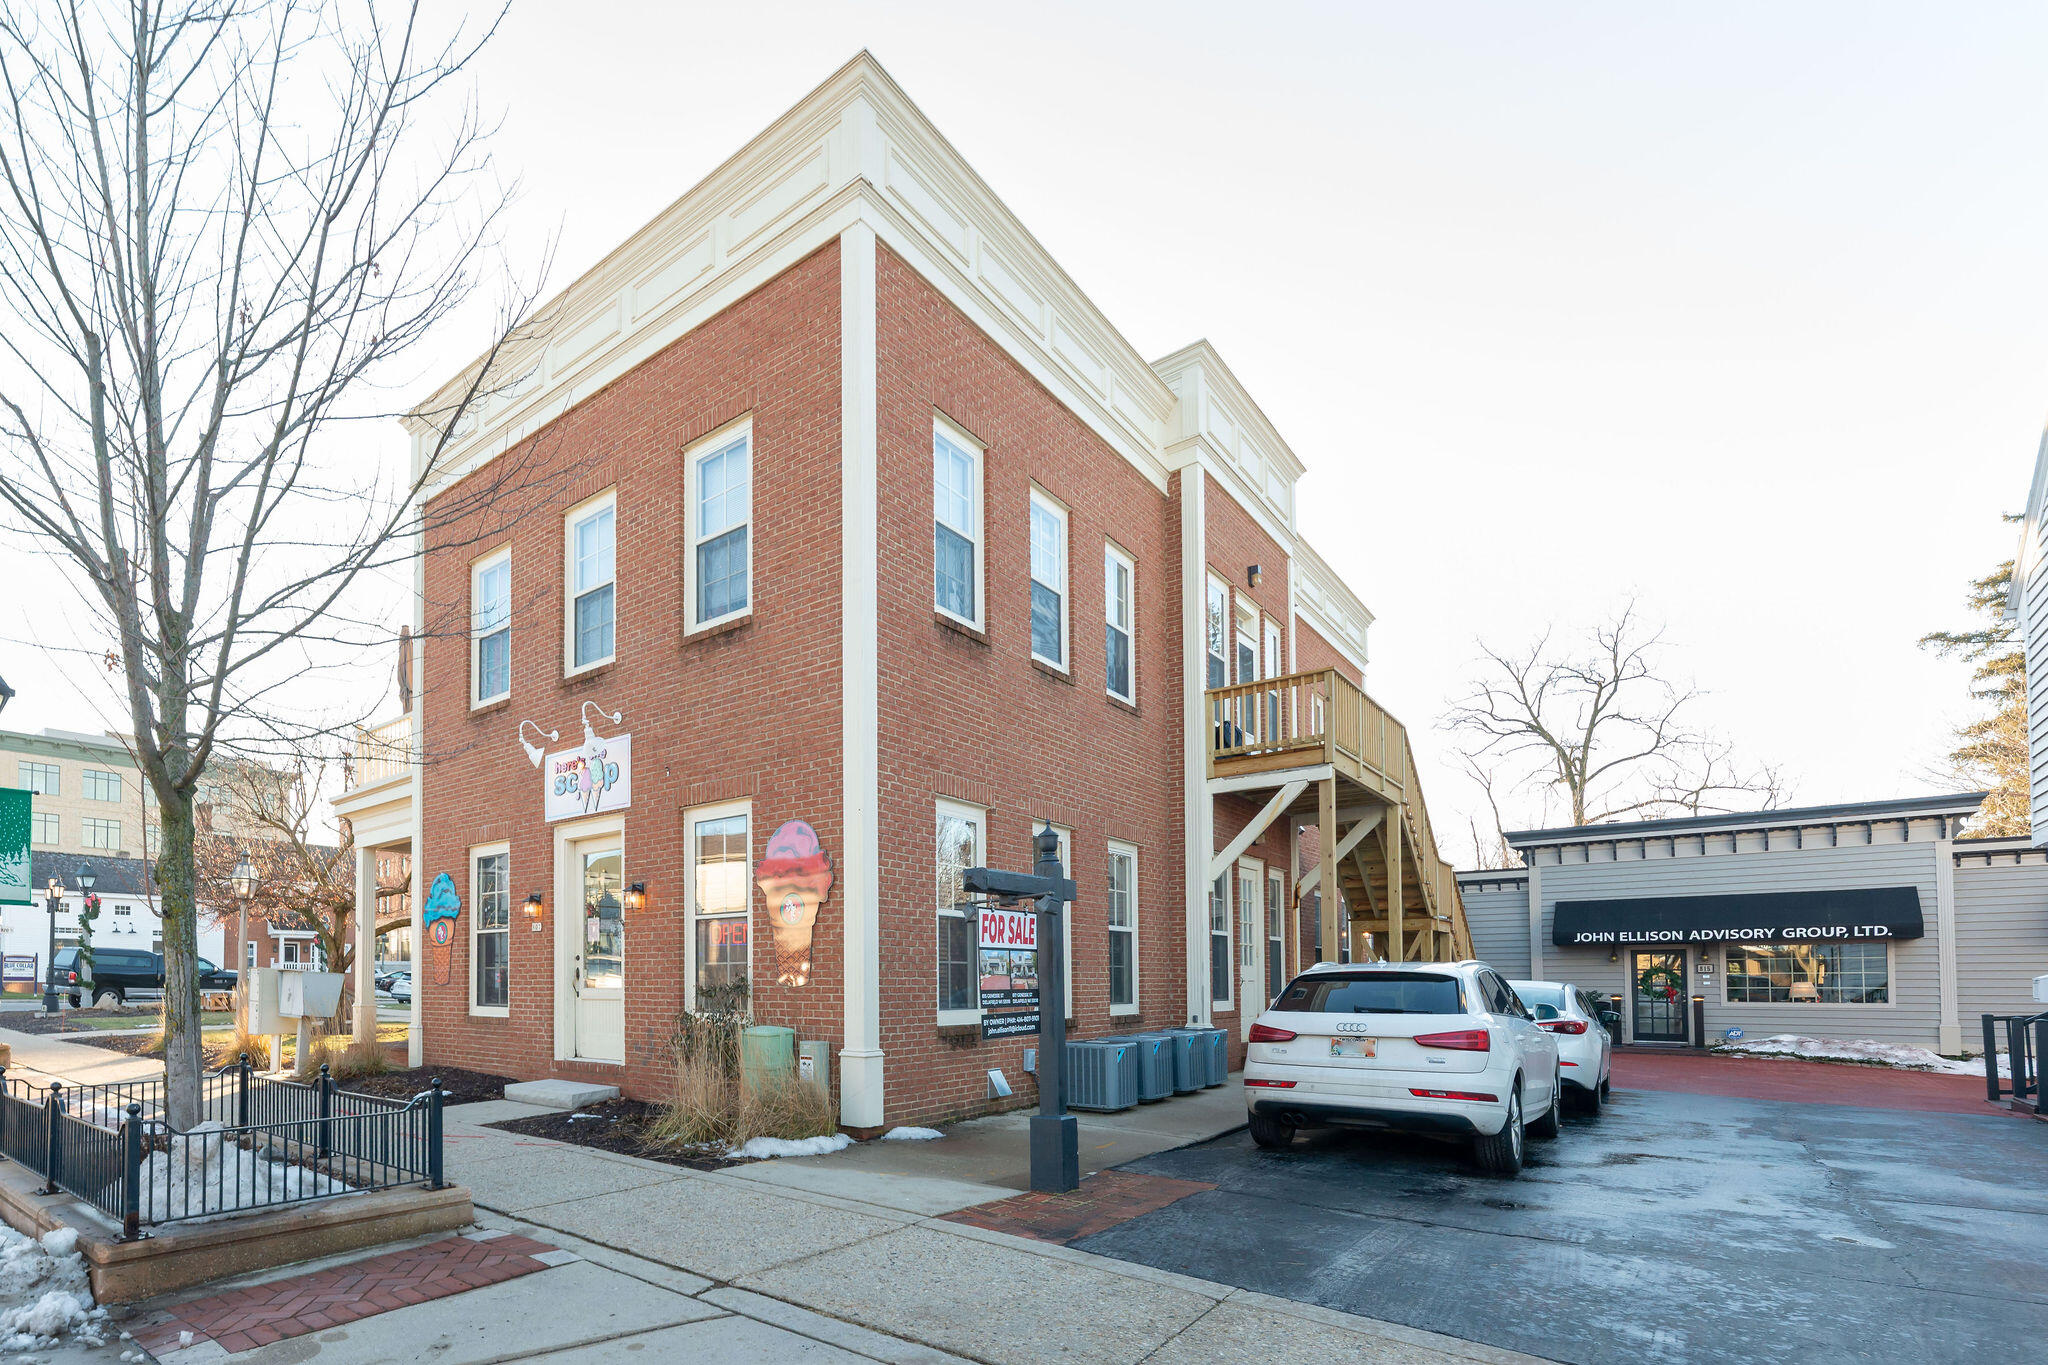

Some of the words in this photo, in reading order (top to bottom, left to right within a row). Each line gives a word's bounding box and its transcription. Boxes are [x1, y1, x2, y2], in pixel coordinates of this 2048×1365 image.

[981, 913, 1005, 944] FOR
[1008, 915, 1036, 945] SALE
[1574, 931, 1615, 943] JOHN
[1619, 930, 1683, 942] ELLISON
[1688, 928, 1776, 941] ADVISORY
[1782, 926, 1849, 939] GROUP,
[1853, 925, 1893, 937] LTD.
[989, 1017, 1005, 1026] OWNER
